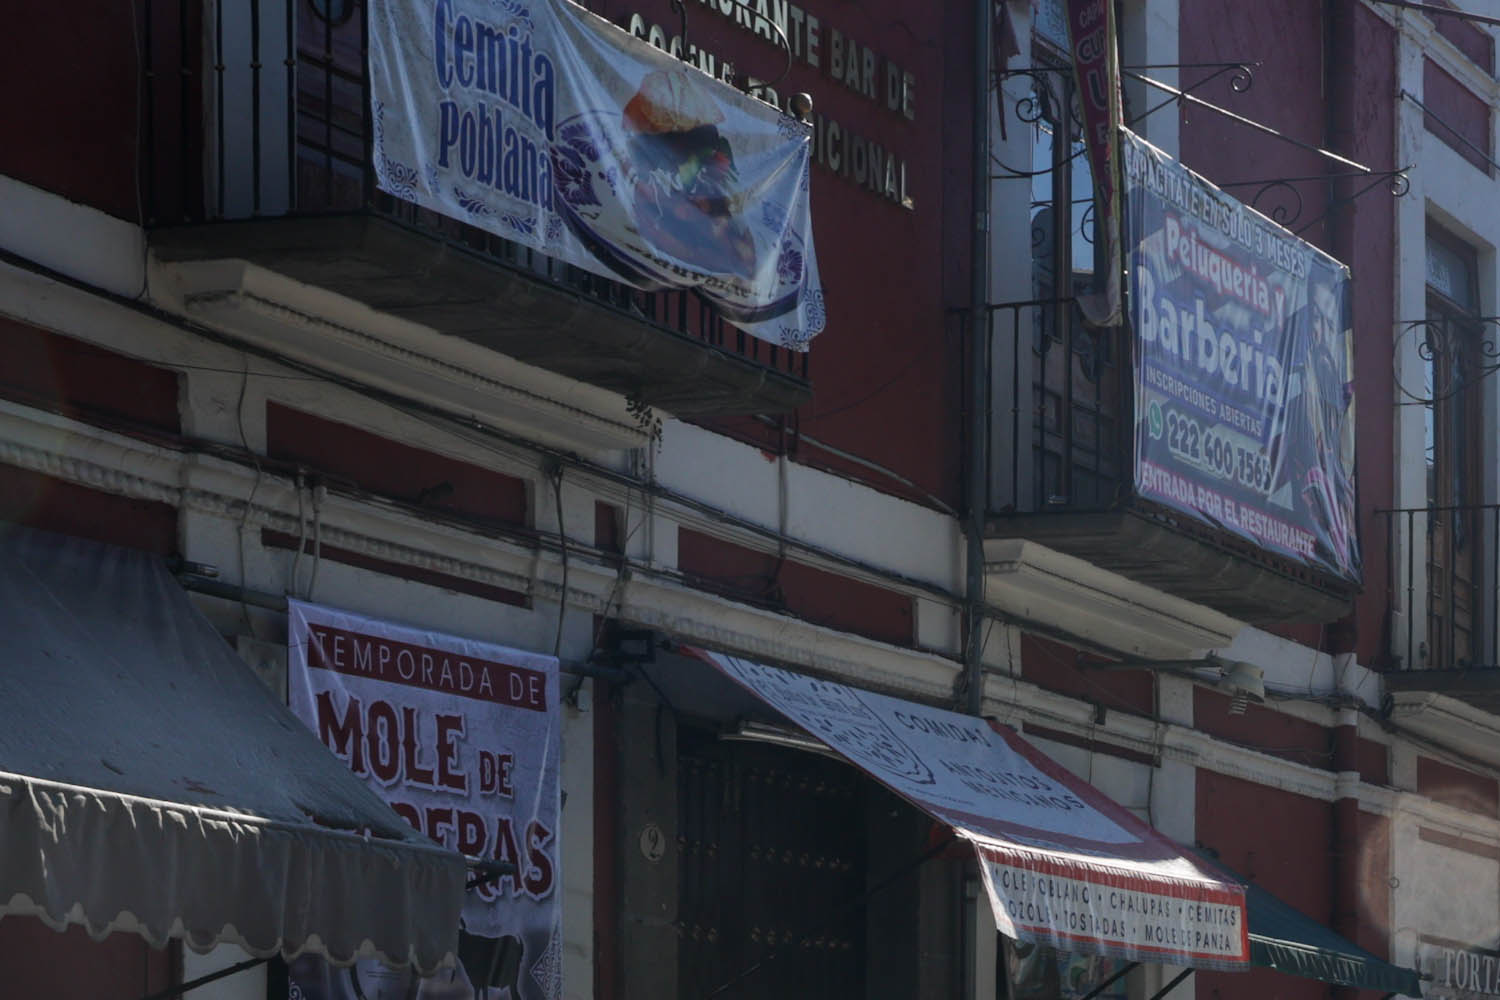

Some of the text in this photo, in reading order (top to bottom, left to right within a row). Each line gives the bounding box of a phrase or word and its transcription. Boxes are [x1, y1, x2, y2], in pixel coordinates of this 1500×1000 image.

[434, 0, 554, 142] Cemita
[830, 27, 877, 100] BAR
[887, 61, 917, 121] DE
[438, 101, 554, 213] Poblana
[1255, 223, 1264, 255] 3
[1266, 233, 1306, 279] MESES
[1138, 265, 1284, 408] Barberia
[1145, 367, 1262, 437] INSCRIPCIONES ABIERTAS
[1167, 412, 1200, 462] 222
[1204, 431, 1234, 478] 400
[1141, 461, 1317, 558] ENTRADA POR EL RESTAURANTE
[316, 631, 540, 705] TEMPORADA DE
[316, 690, 514, 796] MOLE DE
[994, 867, 1027, 892] OLE
[1109, 891, 1171, 919] CHALUPAS
[1187, 905, 1237, 927] CEMITAS
[1063, 910, 1127, 938] TOSTADAS
[1145, 925, 1177, 946] MOLE
[1195, 930, 1232, 952] PANZA
